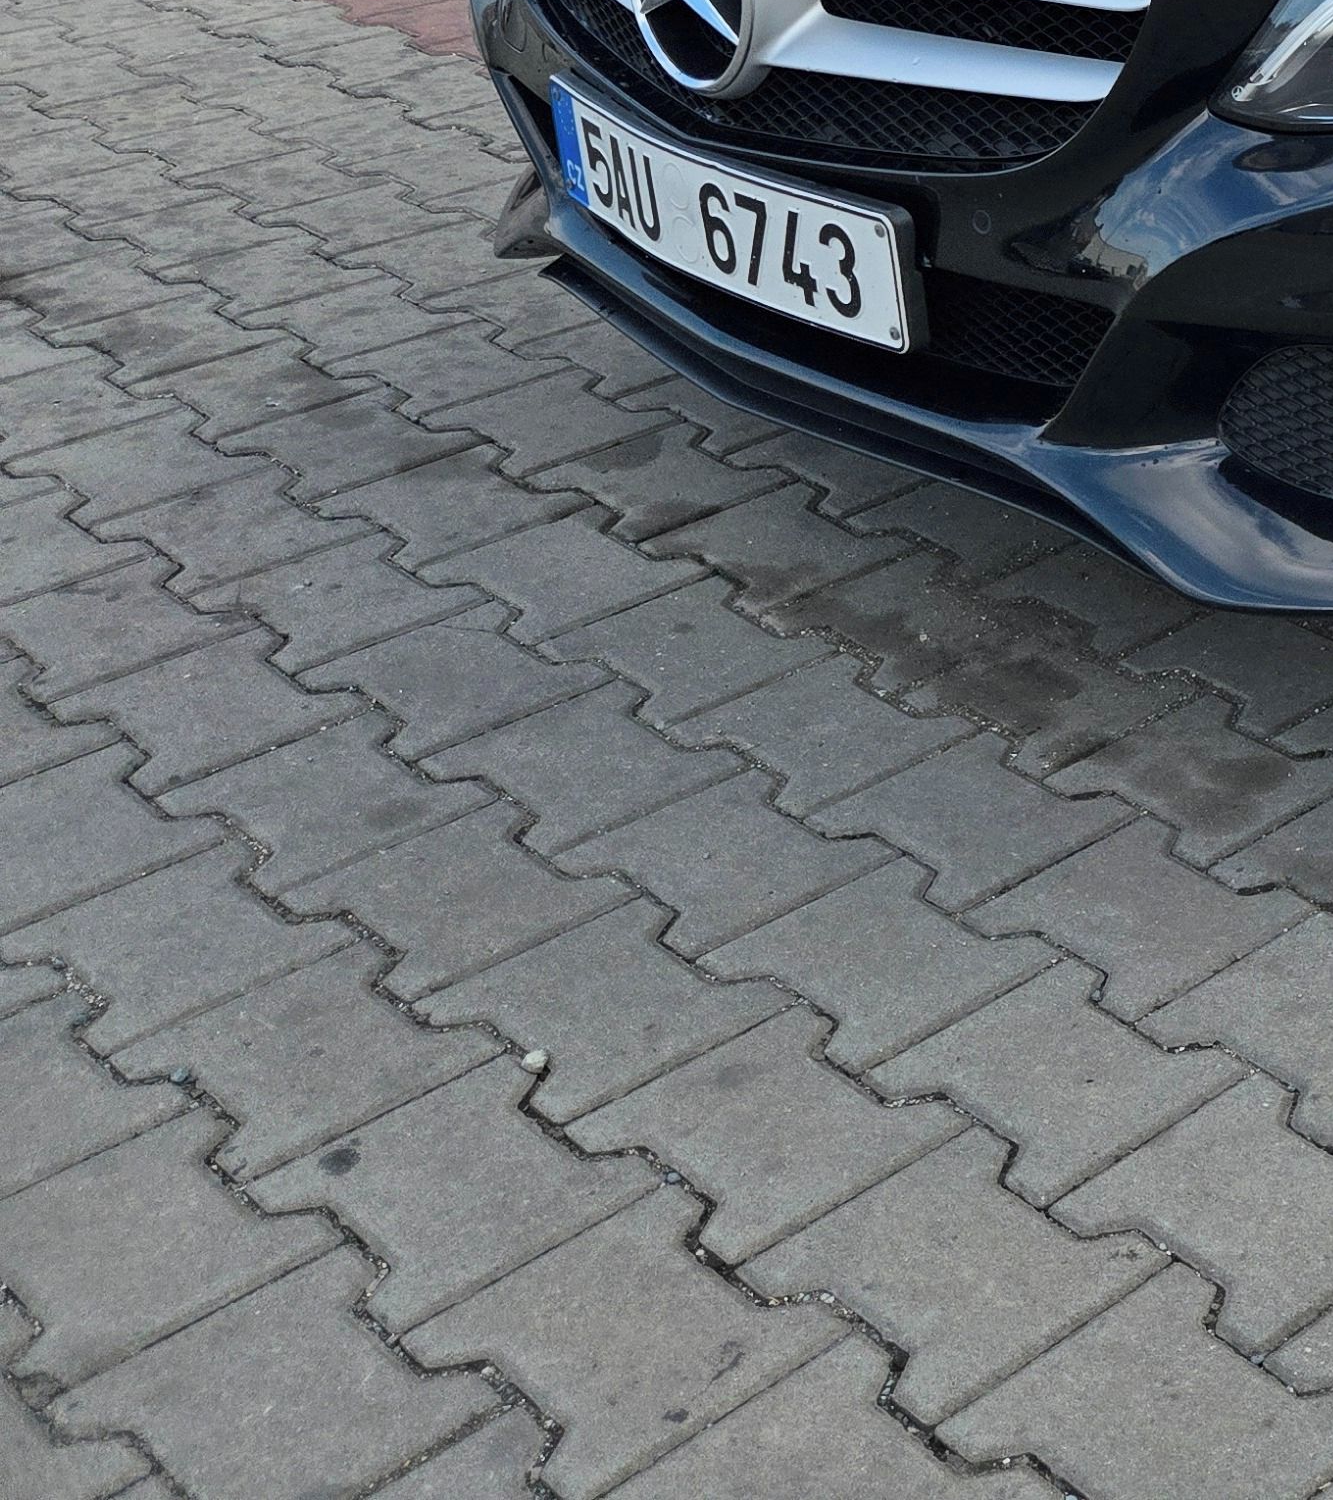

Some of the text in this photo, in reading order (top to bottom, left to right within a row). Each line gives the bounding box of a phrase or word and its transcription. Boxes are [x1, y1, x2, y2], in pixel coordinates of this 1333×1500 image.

[566, 158, 586, 192] CZ
[581, 116, 863, 319] 5AU 6743
